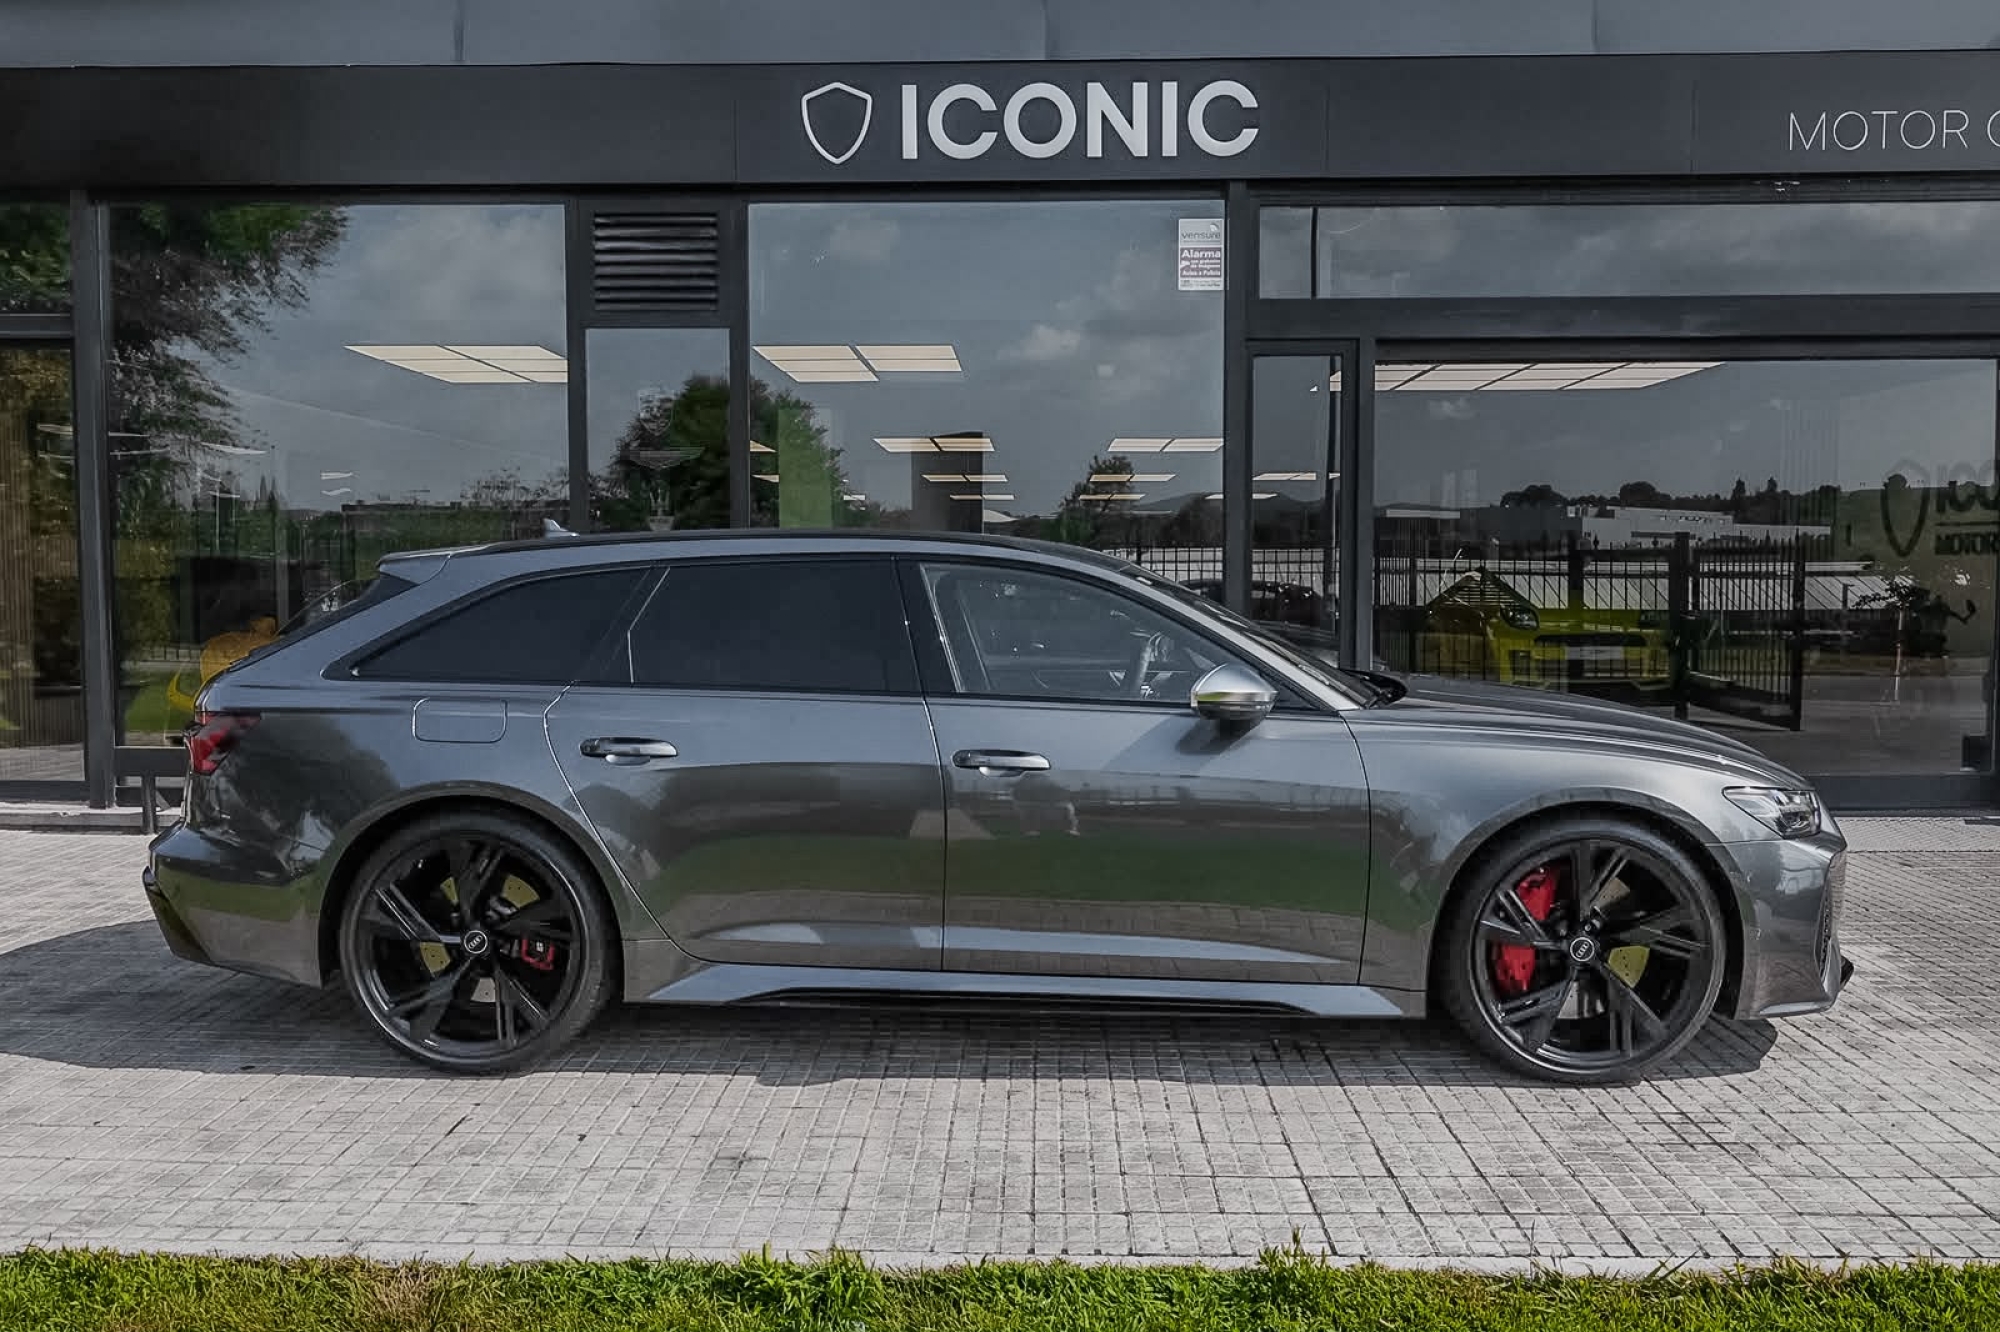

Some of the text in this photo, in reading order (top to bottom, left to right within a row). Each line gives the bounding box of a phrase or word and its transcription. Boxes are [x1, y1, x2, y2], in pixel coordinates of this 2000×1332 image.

[902, 79, 1260, 160] ICONIC
[1789, 109, 1970, 151] MOTOR
[1181, 249, 1221, 258] Alarma
